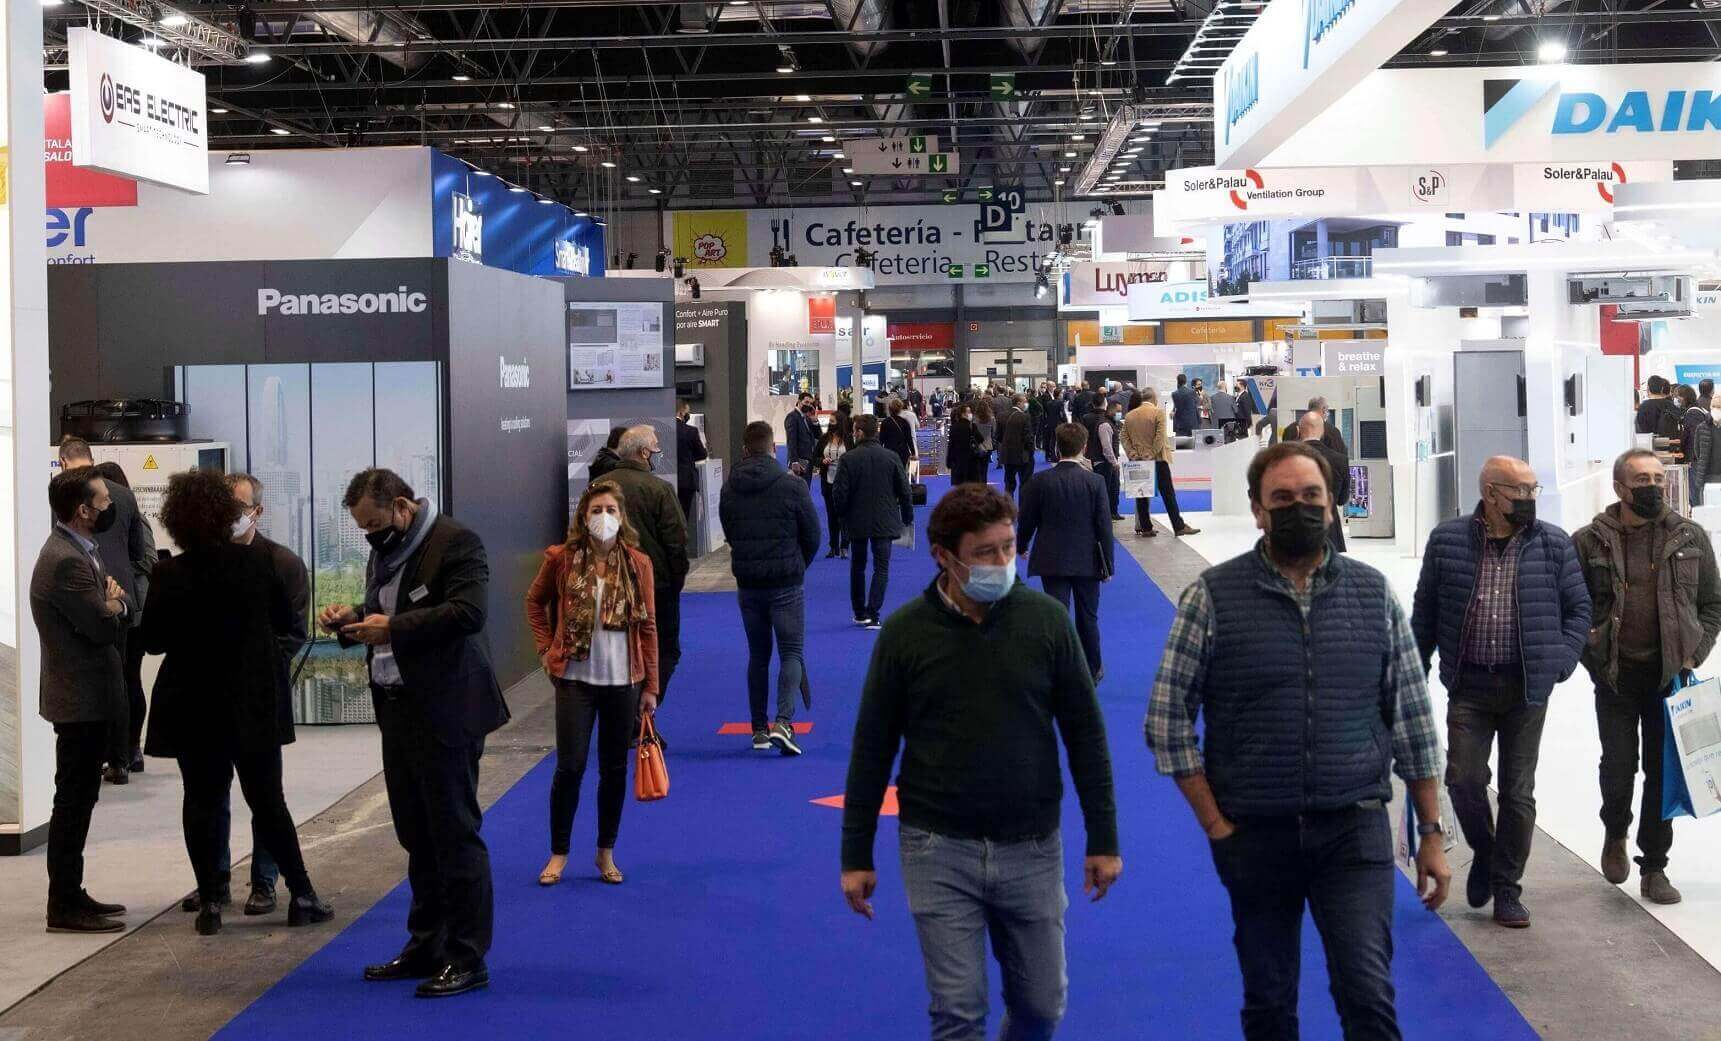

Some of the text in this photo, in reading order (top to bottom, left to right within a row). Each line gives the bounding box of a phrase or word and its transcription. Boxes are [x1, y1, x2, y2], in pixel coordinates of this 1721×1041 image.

[115, 82, 199, 135] EAS ELECTRIC
[1551, 90, 1721, 134] DAIK
[1543, 167, 1613, 181] Soler&Palau
[1183, 177, 1247, 192] Soler&Palau
[1418, 176, 1440, 196] S&P
[1246, 188, 1325, 200] Ventilation Group
[986, 205, 1006, 227] D
[805, 220, 941, 246] Cafetería
[698, 241, 715, 250] POP
[704, 249, 721, 257] ART
[835, 250, 1043, 275] Cfeteria Rest
[257, 285, 427, 315] Panasonic
[675, 309, 697, 318] Confort
[702, 309, 714, 317] Aire
[714, 308, 729, 316] Puro
[676, 319, 719, 330] por aire SMART
[1337, 351, 1380, 361] breathe
[499, 355, 530, 388] Panasonic
[1338, 362, 1376, 371] & relax
